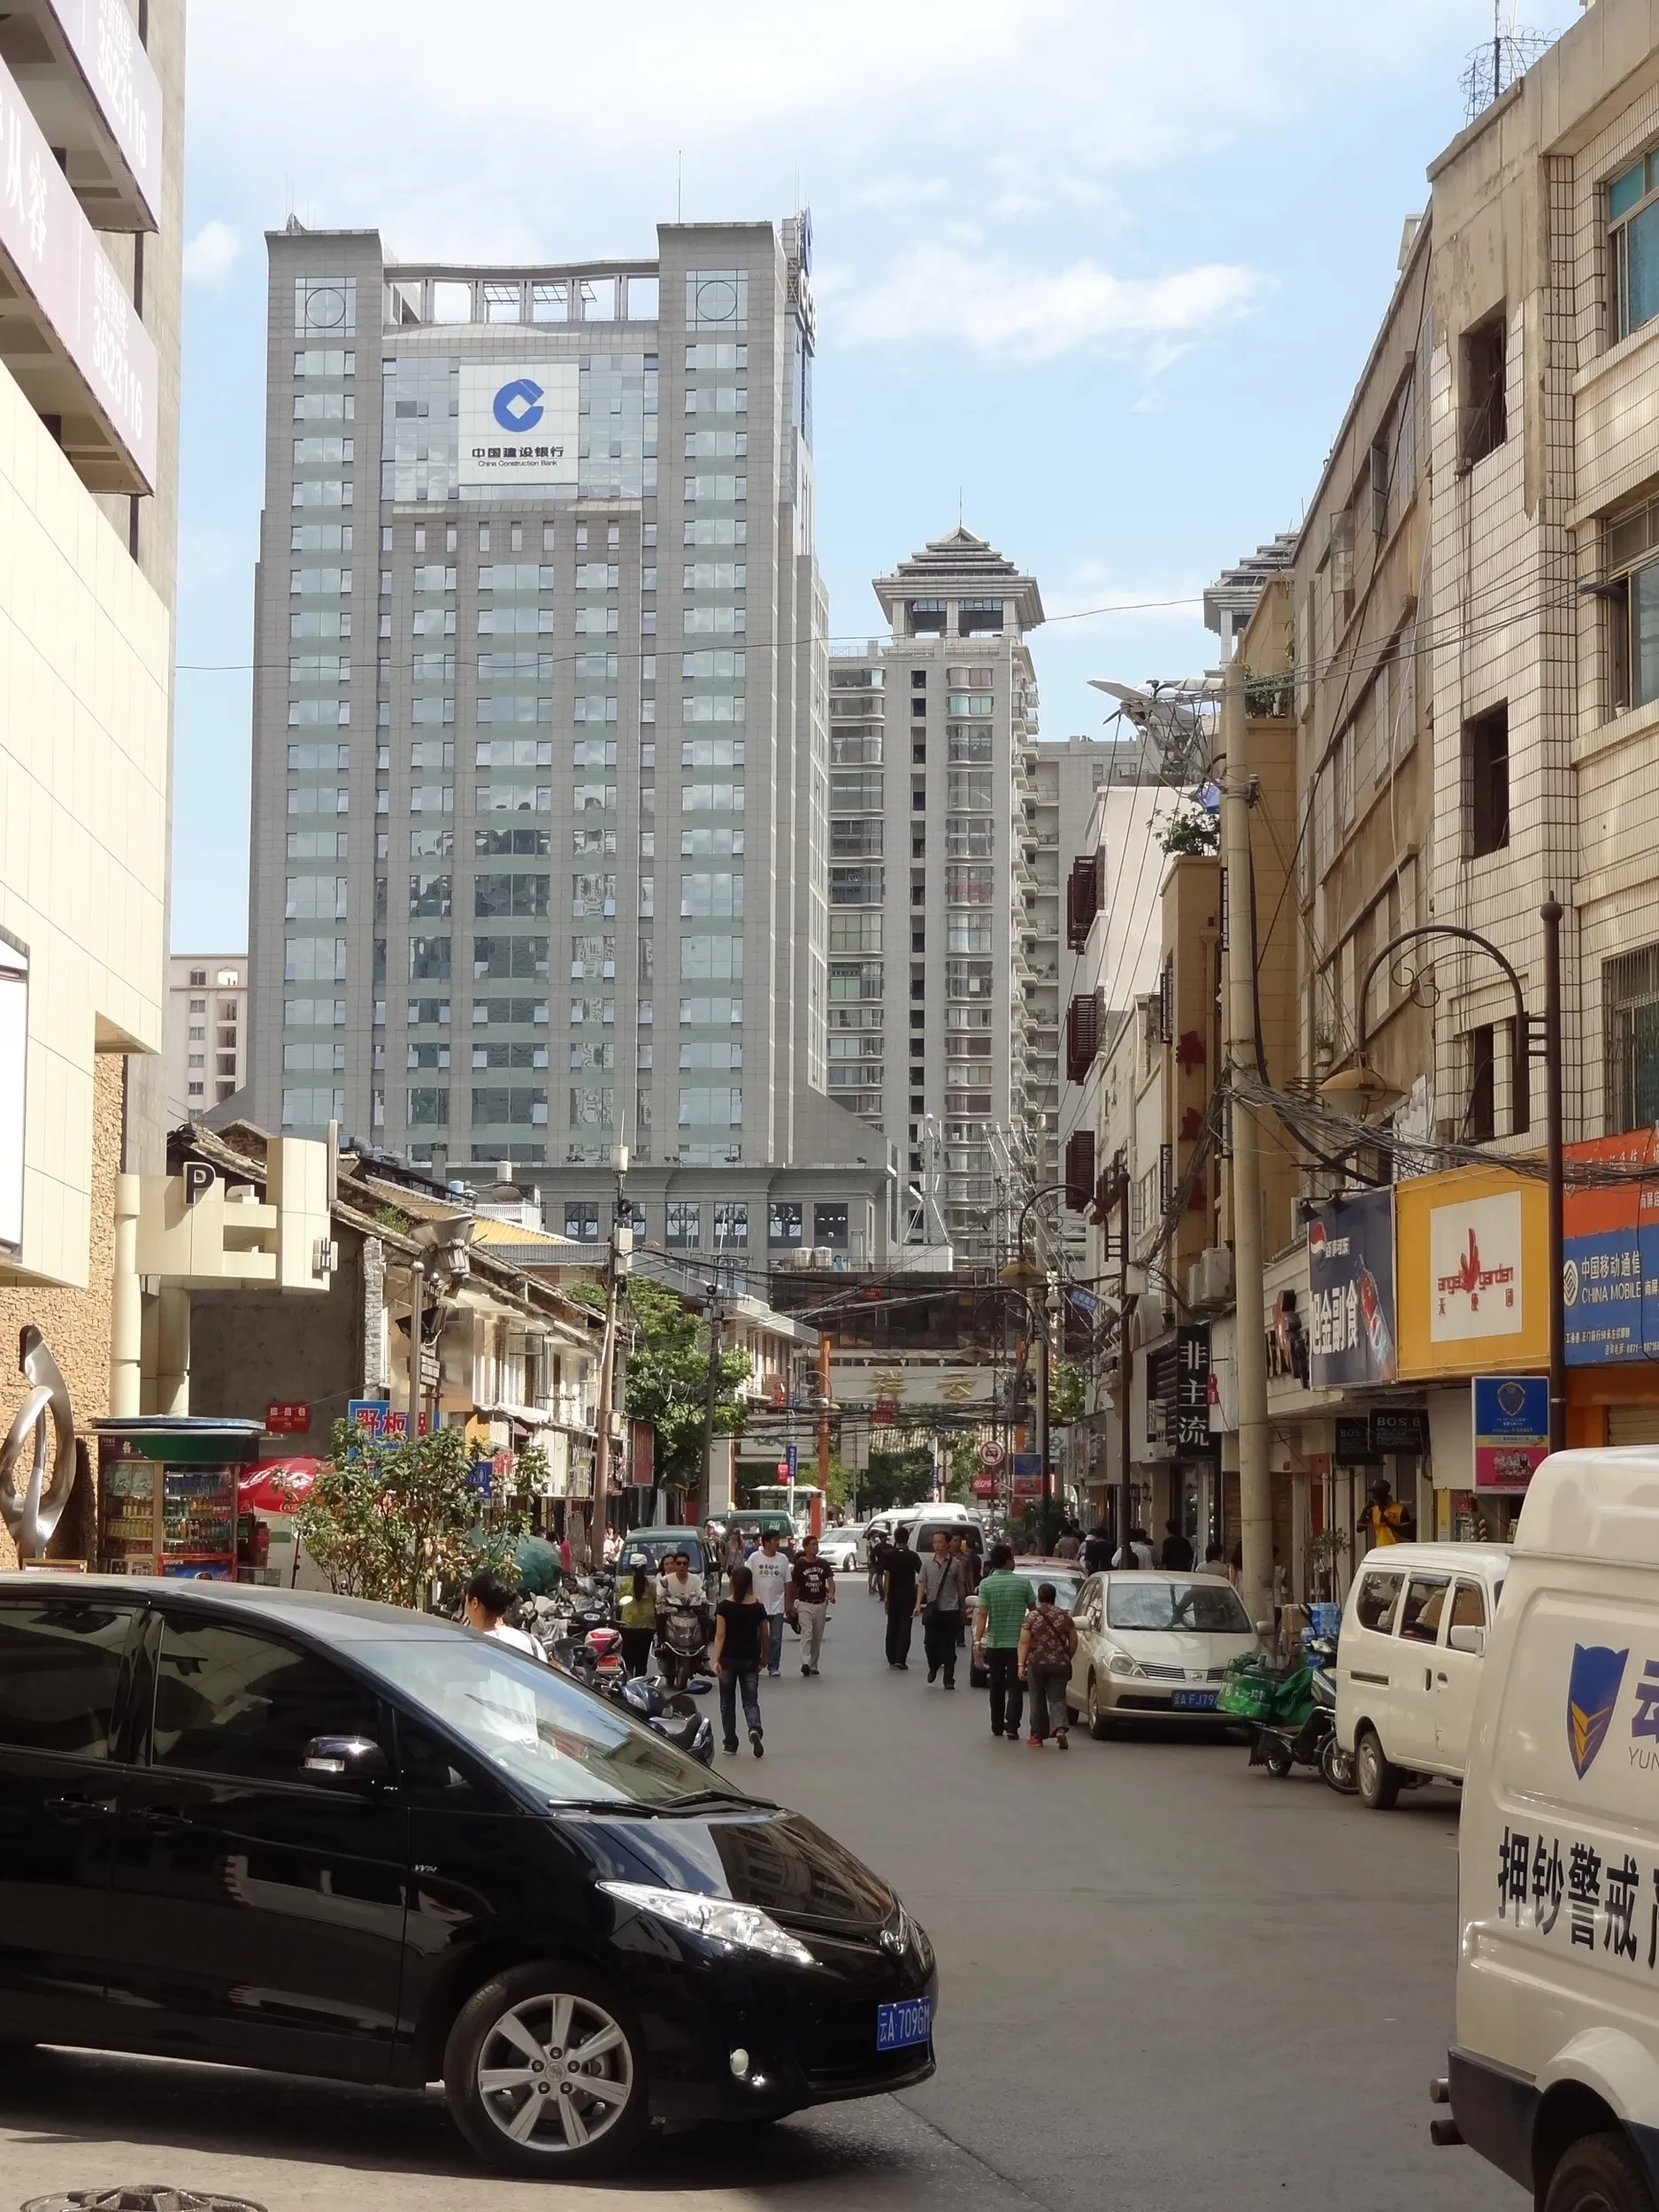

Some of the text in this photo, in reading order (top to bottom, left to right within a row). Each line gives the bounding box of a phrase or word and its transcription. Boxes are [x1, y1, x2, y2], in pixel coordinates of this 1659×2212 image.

[472, 446, 565, 458] 中国建设银行
[182, 1161, 216, 1205] P
[1581, 1250, 1640, 1281] 中国移动通信
[1581, 1281, 1641, 1303] CHINA MOBILE
[866, 1369, 979, 1402] 祥云
[1178, 1340, 1210, 1447] 非主流
